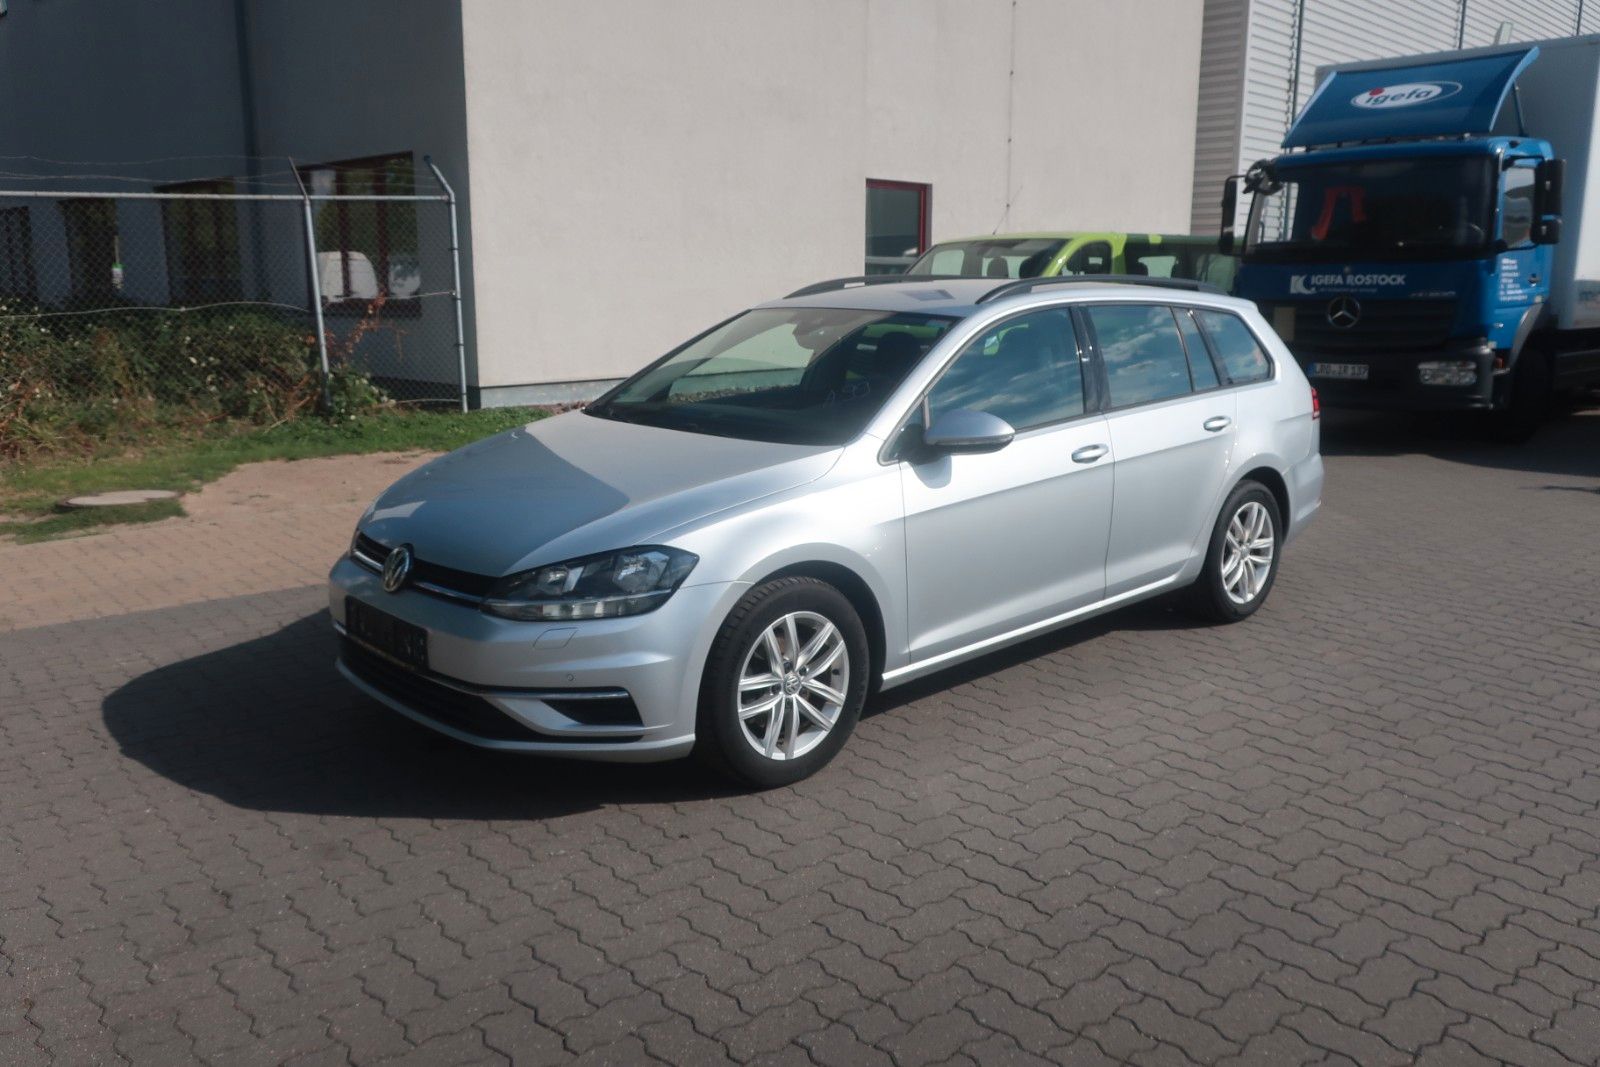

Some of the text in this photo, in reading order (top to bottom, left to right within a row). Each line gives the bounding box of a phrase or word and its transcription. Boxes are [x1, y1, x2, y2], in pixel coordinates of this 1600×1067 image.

[1365, 87, 1433, 105] igefa
[1311, 275, 1343, 285] IGEFA
[1346, 274, 1407, 286] ROSTOCK
